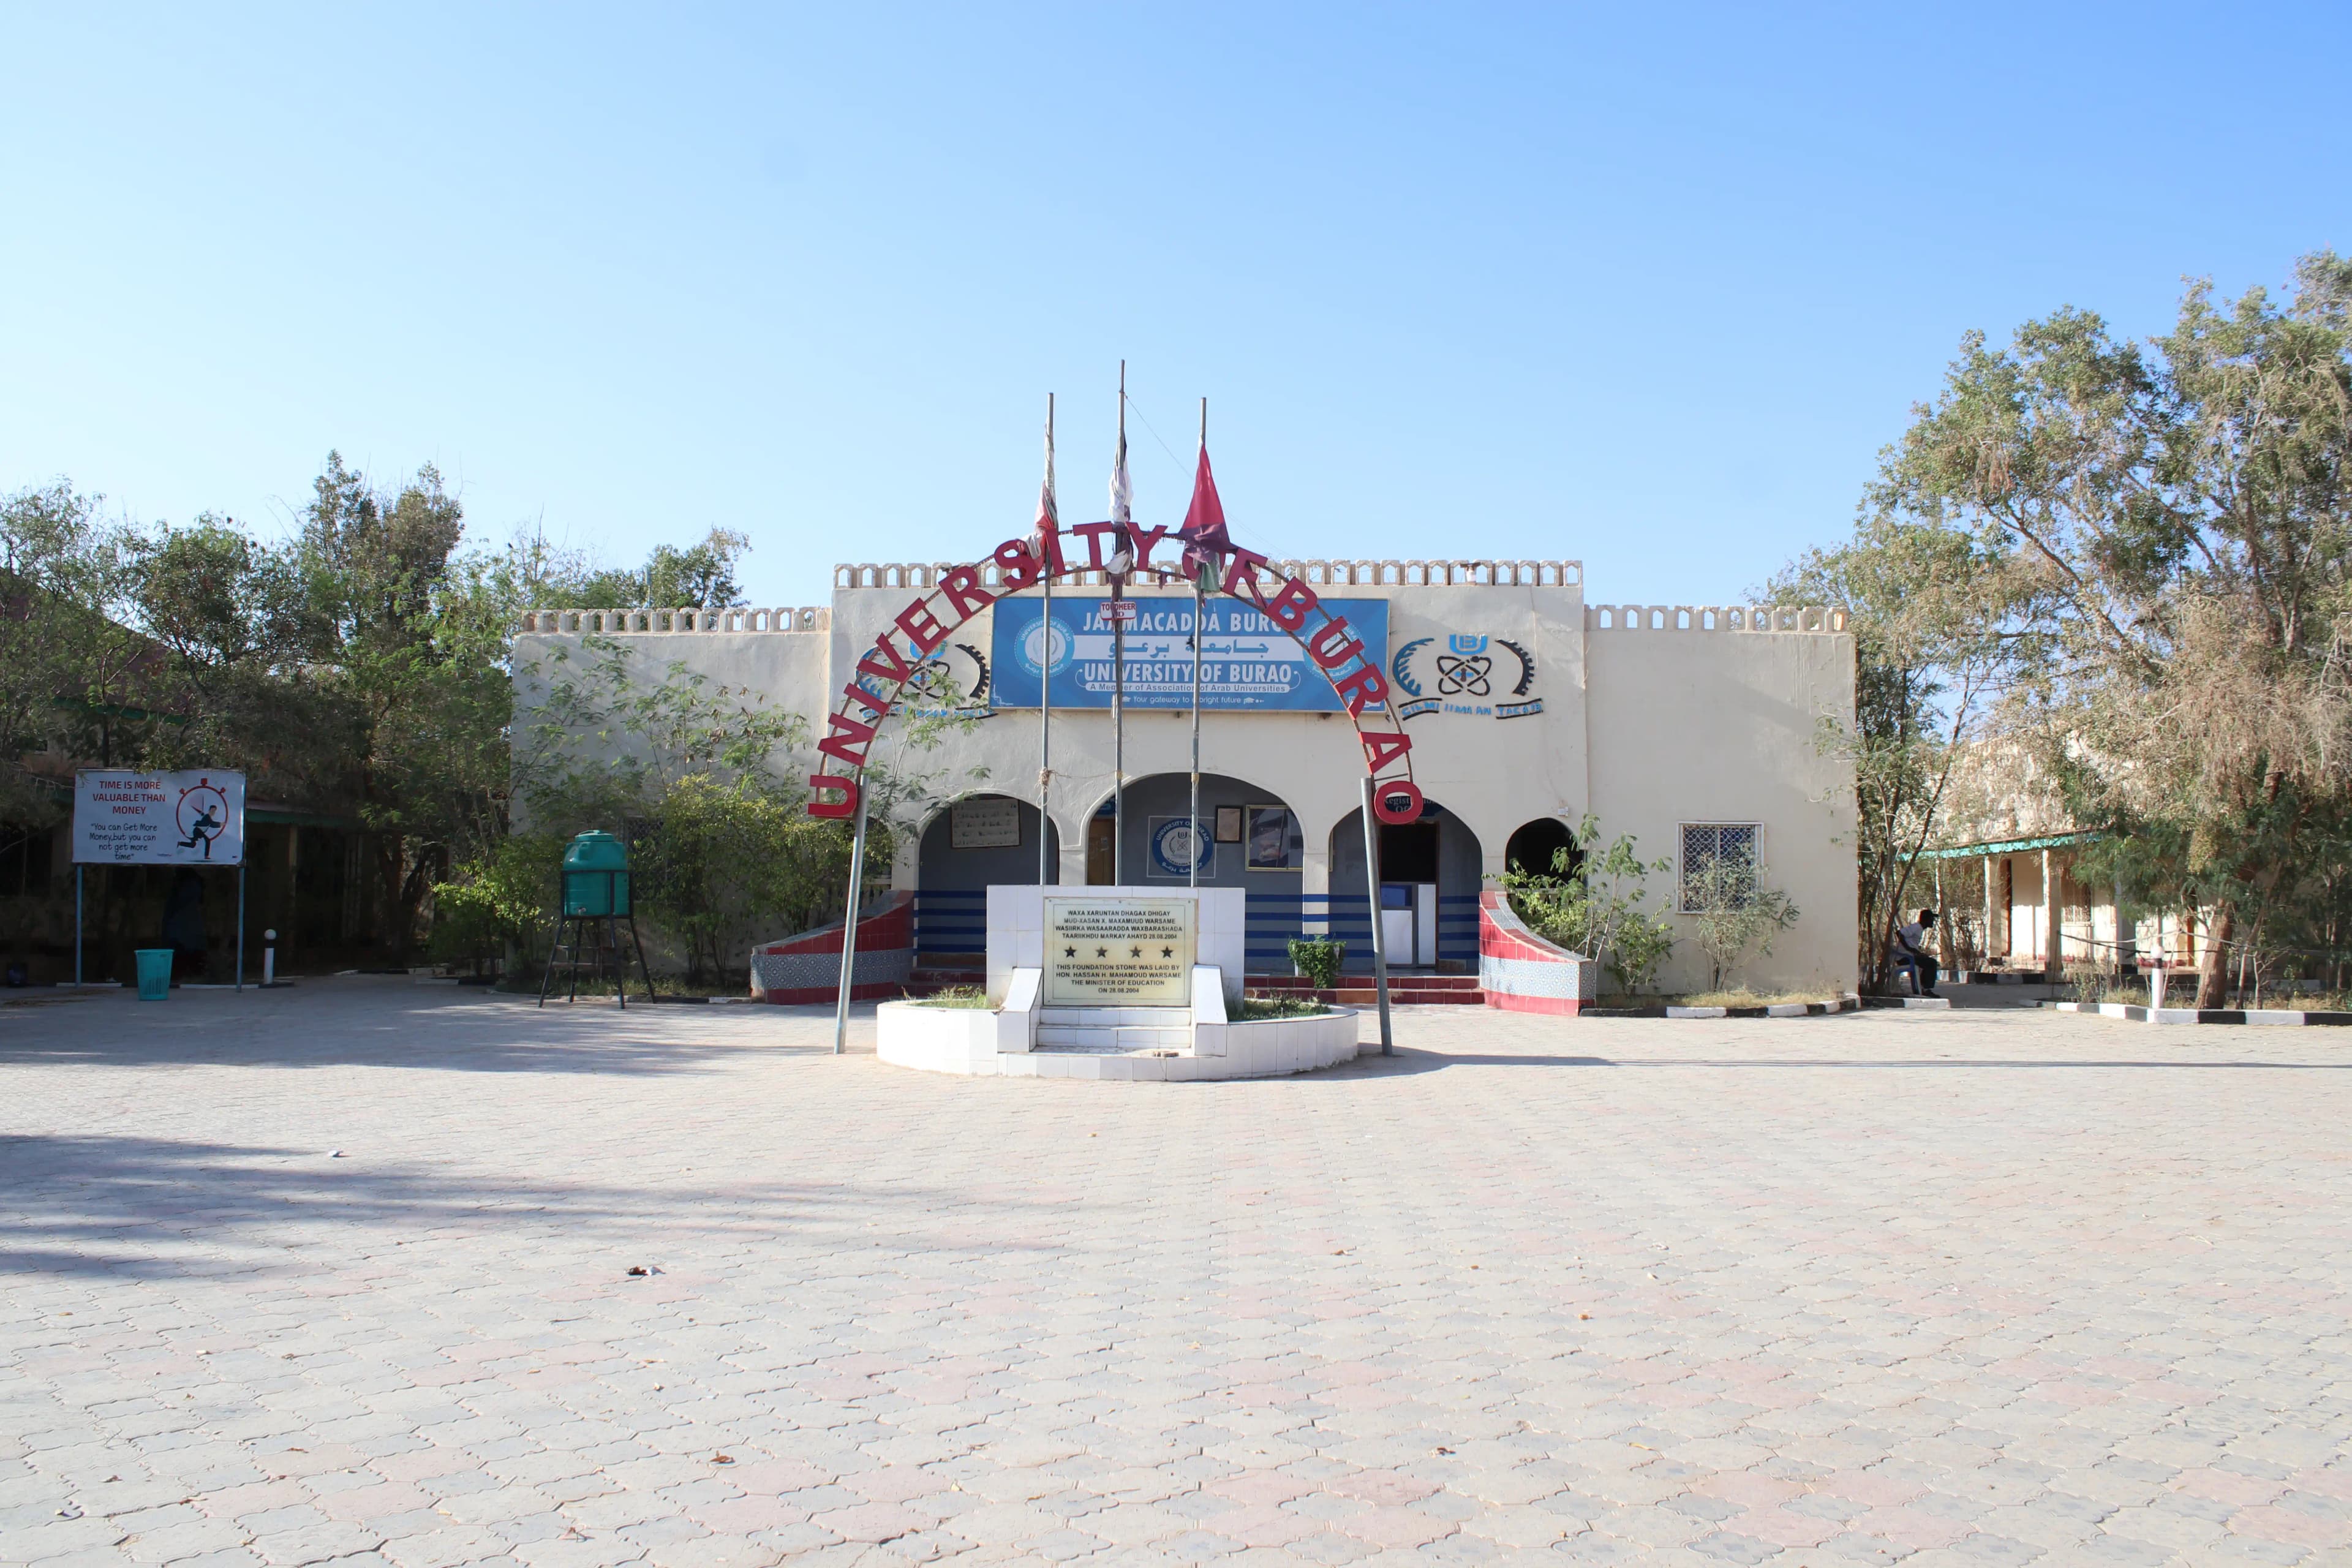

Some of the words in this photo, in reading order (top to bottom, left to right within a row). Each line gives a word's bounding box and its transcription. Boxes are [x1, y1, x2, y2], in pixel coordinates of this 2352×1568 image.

[807, 521, 1168, 818] UNIVERSITY
[1265, 576, 1423, 824] BURAO
[1084, 663, 1193, 682] UNIVERSITY
[1199, 663, 1222, 682] OF
[1229, 664, 1292, 683] BURAO
[115, 843, 128, 852] get
